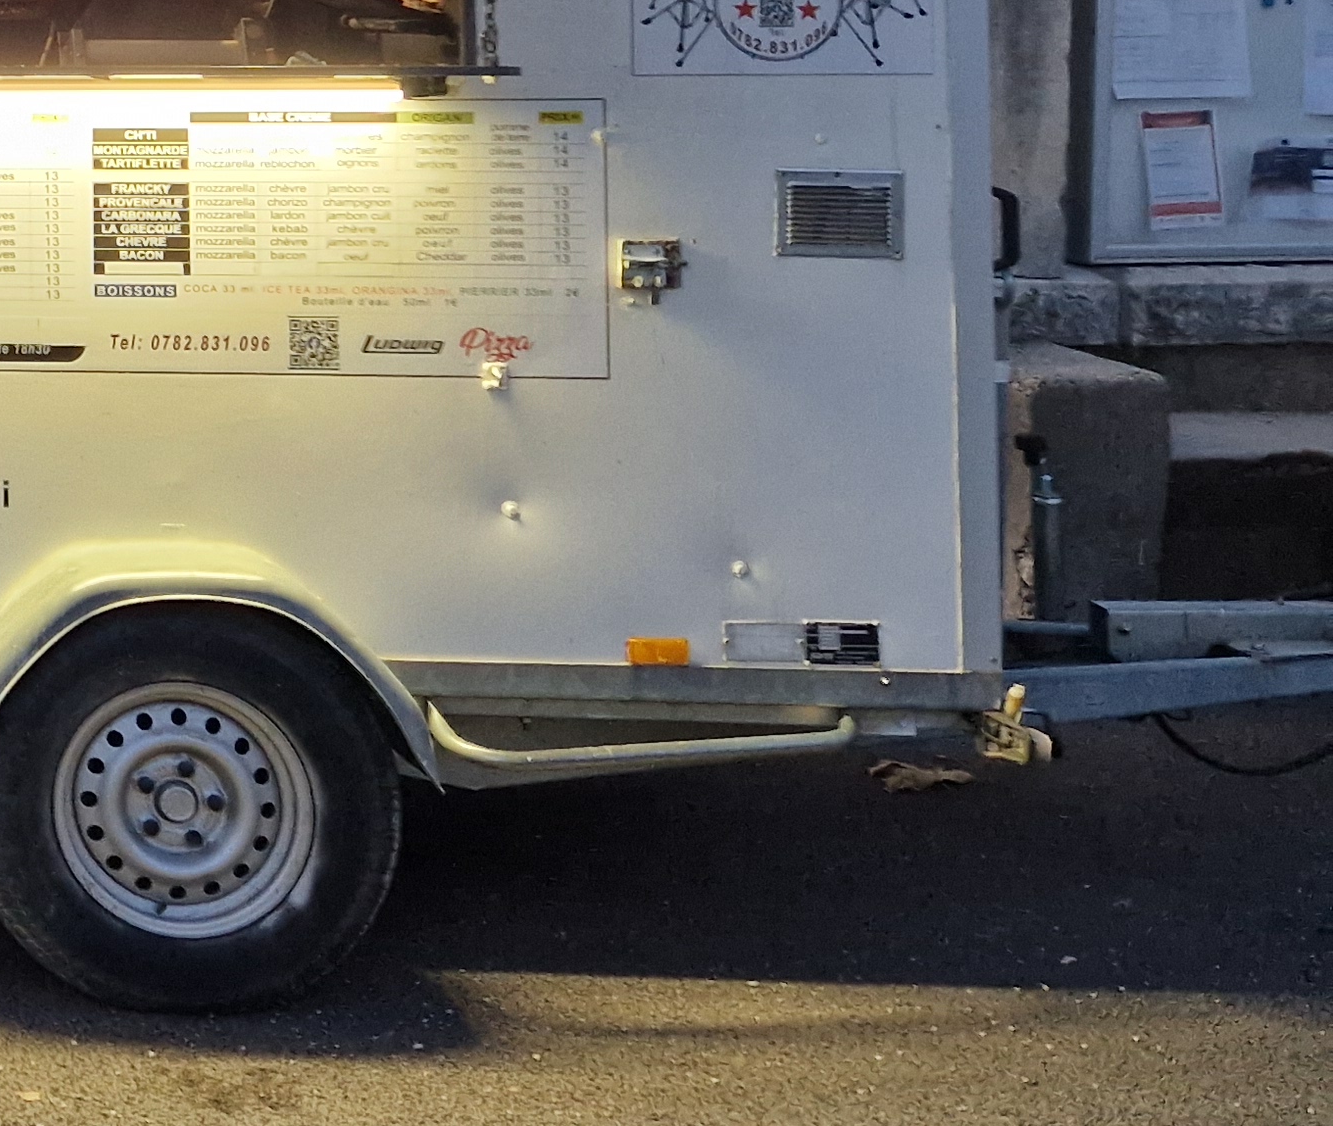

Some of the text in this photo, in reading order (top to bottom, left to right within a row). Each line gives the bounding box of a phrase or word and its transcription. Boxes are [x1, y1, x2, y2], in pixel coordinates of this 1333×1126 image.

[93, 145, 187, 155] MONTAGNARDE
[100, 158, 180, 168] TARTIFLETTE
[45, 172, 59, 180] 13
[45, 185, 59, 193] 13
[111, 184, 171, 194] FRANCKY
[327, 185, 369, 194] jambon
[45, 198, 59, 206] 13
[267, 198, 308, 206] chorizo
[323, 199, 391, 209] champignon
[45, 211, 60, 220] 13
[102, 211, 181, 220] CARBONARA
[326, 212, 367, 222] jambon
[45, 224, 60, 233] 13
[101, 225, 118, 234] LA
[121, 225, 181, 234] GRECQUE
[196, 225, 256, 233] mozzarella
[272, 225, 308, 233] kebab
[46, 237, 60, 246] 13
[270, 238, 308, 246] chèvre
[46, 251, 60, 259] 13
[119, 251, 164, 260] BACON
[270, 251, 307, 260] bacon
[46, 264, 60, 272] 13
[46, 276, 60, 286] 13
[46, 289, 60, 299] 13
[97, 286, 175, 296] BOISSONS
[184, 284, 217, 293] COCA
[263, 285, 282, 294] ICE
[288, 285, 310, 294] TEA
[111, 334, 271, 352] Tel: 0782.831.096
[459, 327, 534, 362] Pizza
